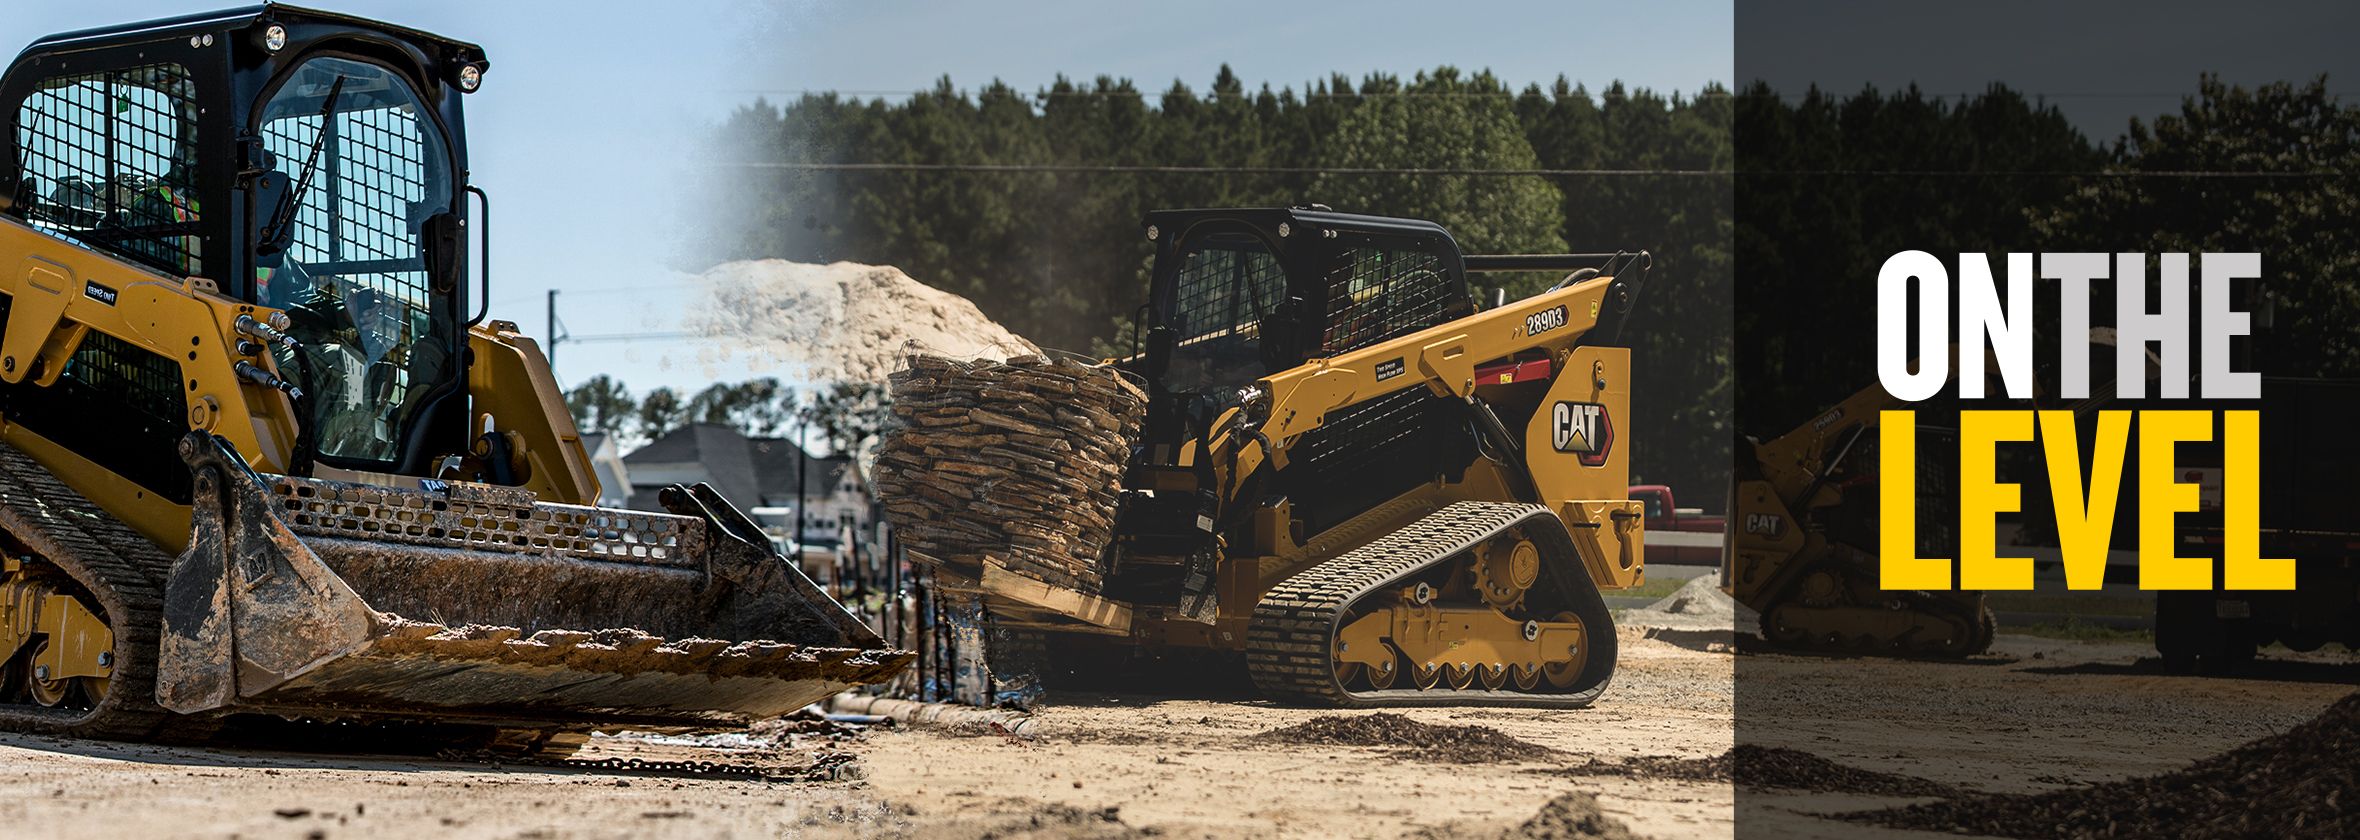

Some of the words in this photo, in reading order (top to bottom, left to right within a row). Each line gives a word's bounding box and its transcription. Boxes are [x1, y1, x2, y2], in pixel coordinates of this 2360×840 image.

[1527, 307, 1563, 335] 289D3
[1554, 402, 1600, 451] CAT
[1746, 513, 1780, 536] CAT
